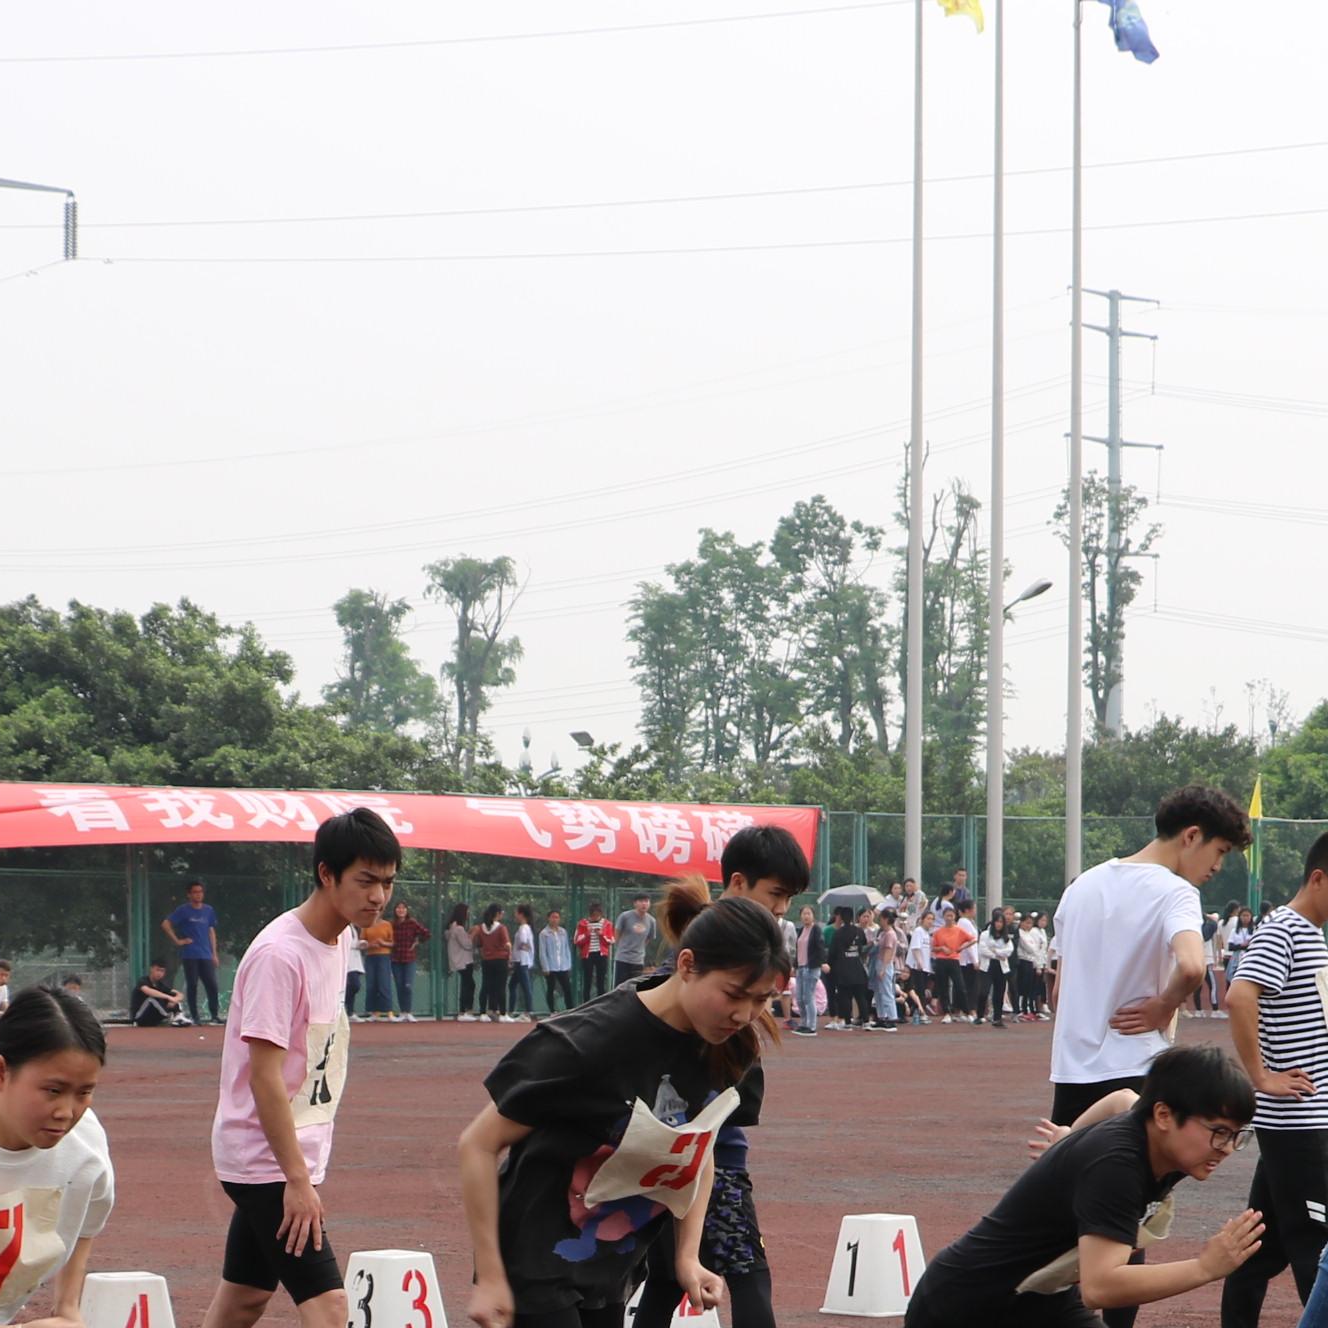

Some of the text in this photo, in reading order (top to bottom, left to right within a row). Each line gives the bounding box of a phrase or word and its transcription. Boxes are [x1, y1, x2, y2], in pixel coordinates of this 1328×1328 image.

[34, 787, 415, 834] 看我财院
[846, 1239, 860, 1297] 1
[892, 1229, 911, 1297] 1
